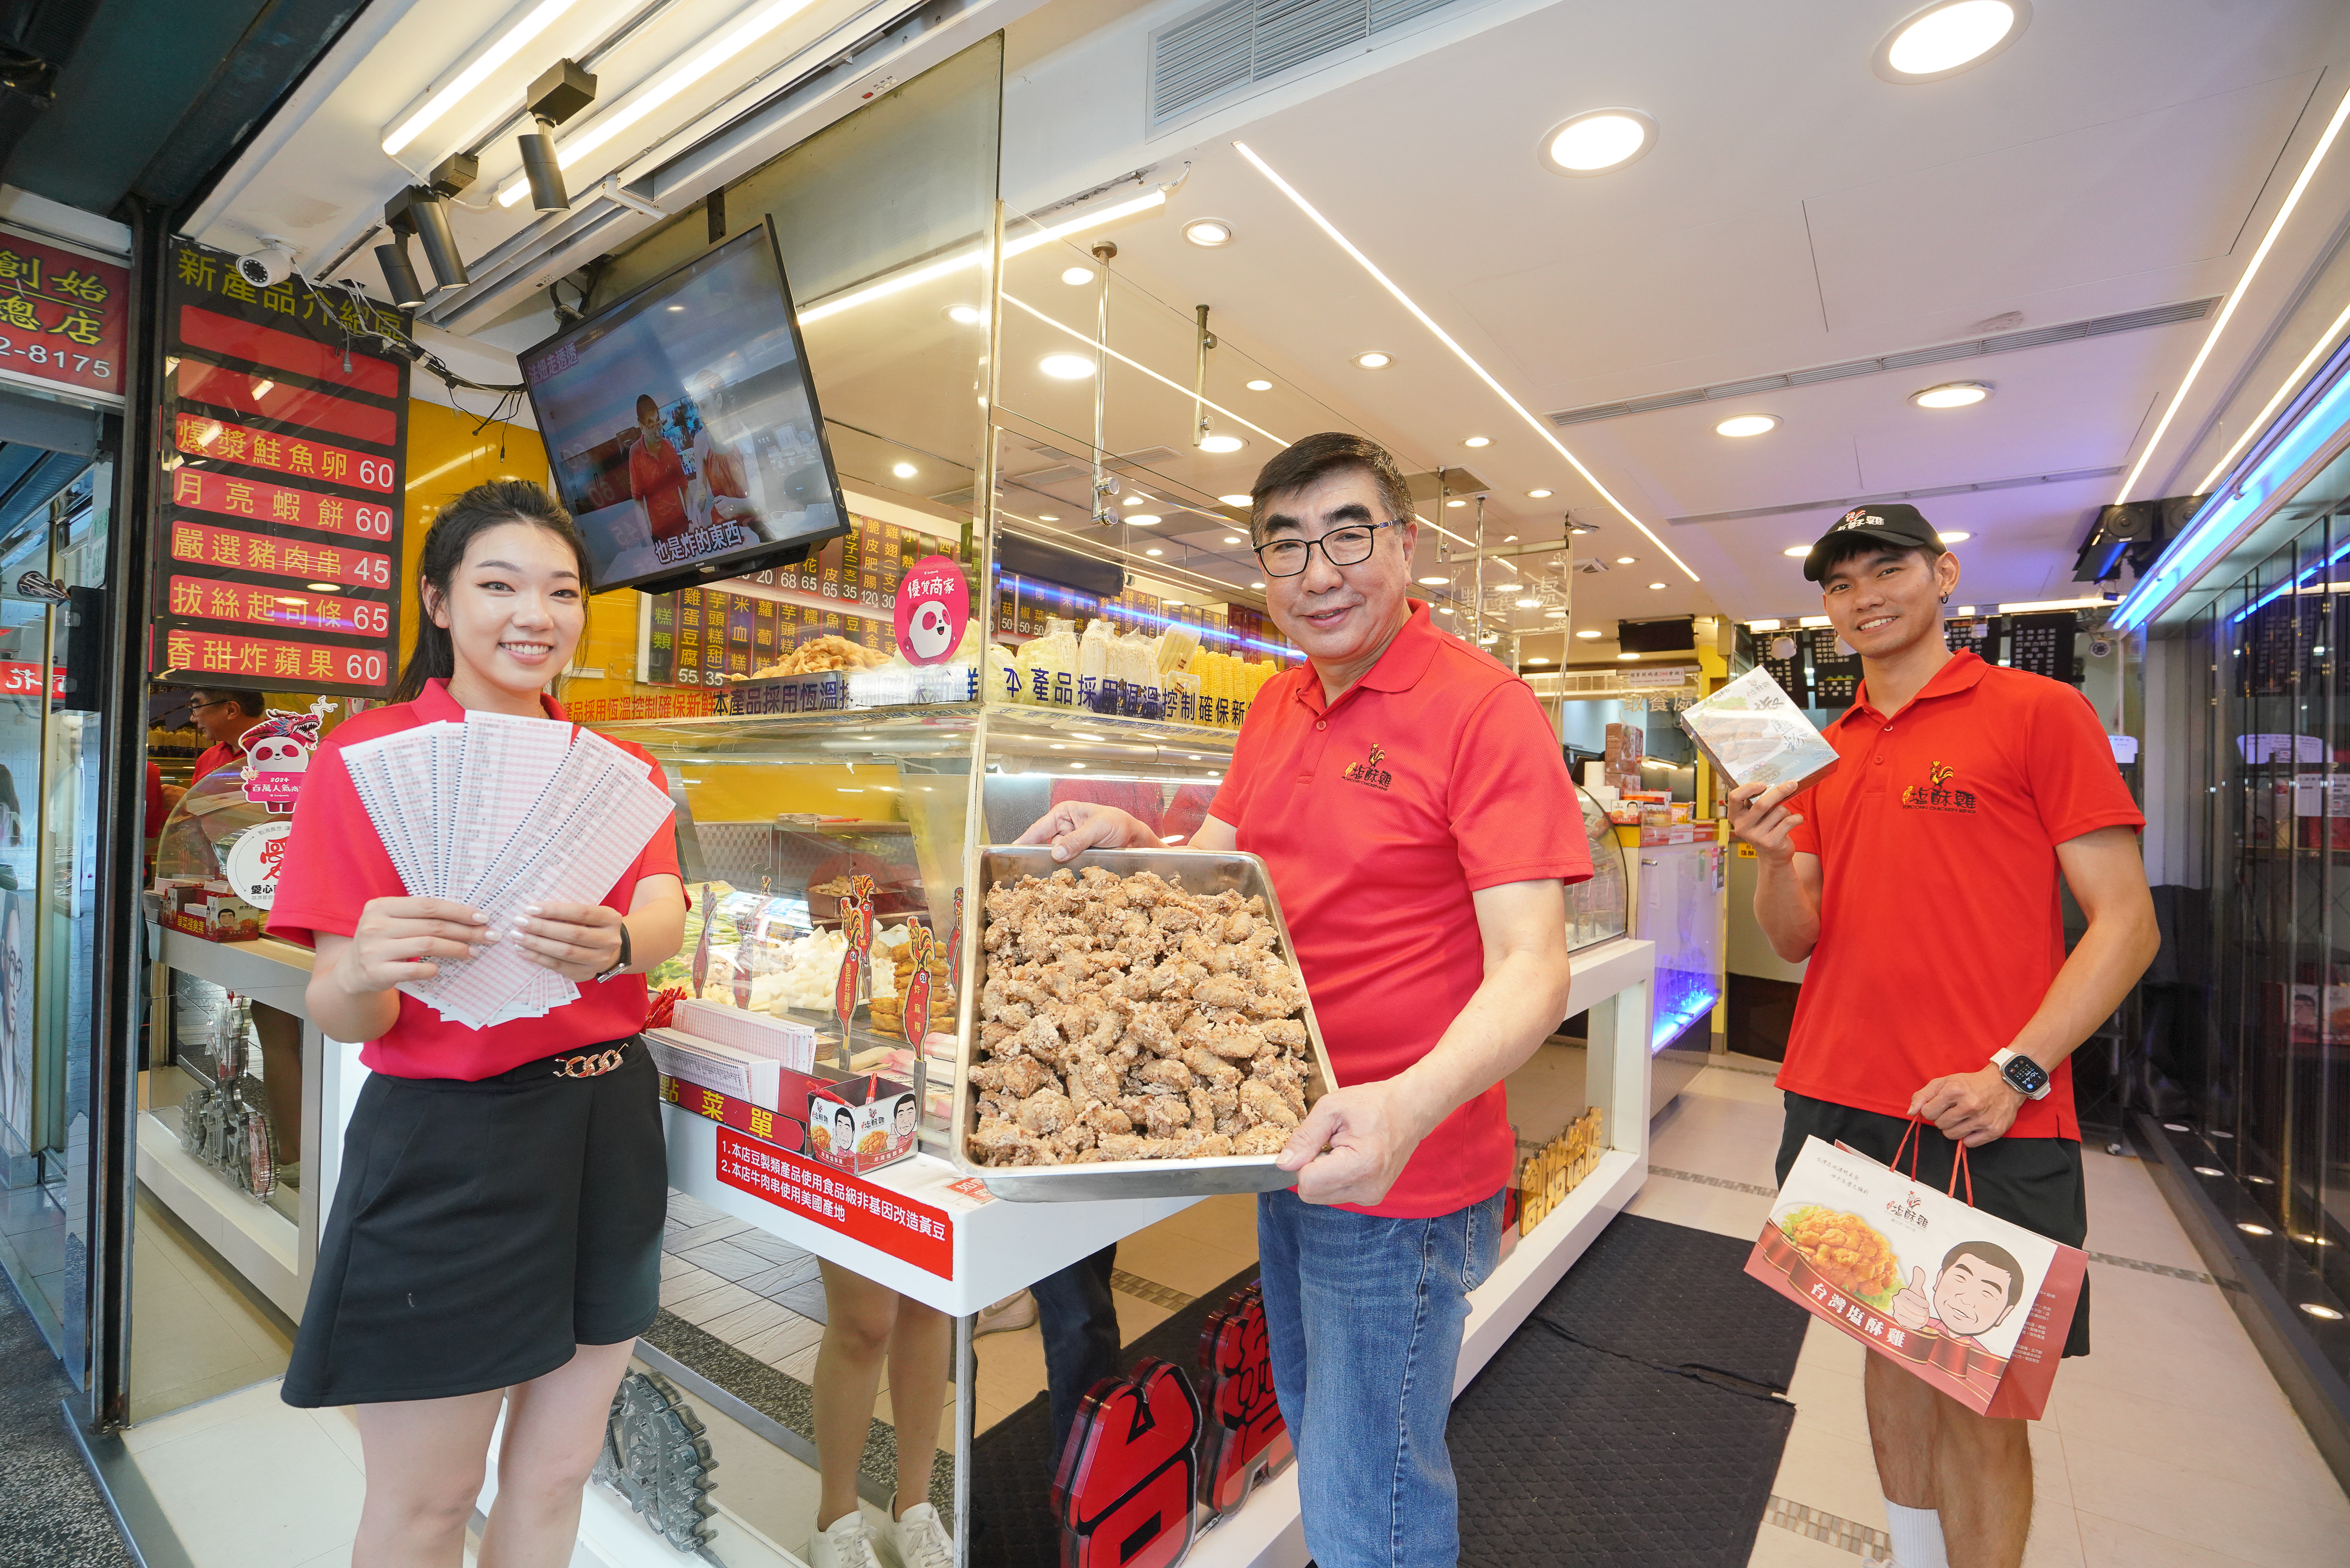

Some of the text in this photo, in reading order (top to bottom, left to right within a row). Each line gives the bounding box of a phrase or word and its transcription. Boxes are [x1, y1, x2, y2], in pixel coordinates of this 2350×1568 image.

[0, 251, 108, 303] 創始
[178, 248, 405, 343] 新產品介紹區
[0, 295, 102, 345] 總店
[0, 336, 110, 378] 2-8175
[179, 420, 393, 488] 爆漿鮭魚卵 60
[179, 473, 390, 535] 月亮蝦餅 60
[173, 527, 389, 584] 嚴選豬肉串 45
[655, 519, 742, 563] 也是炸的東西
[862, 519, 880, 605] 脆皮肥腸 120
[757, 570, 773, 584] 20
[781, 572, 797, 588] 68
[801, 576, 817, 591] 65
[823, 567, 838, 597] 皮 65
[882, 525, 899, 609] 雞翅(一支) 30
[907, 576, 955, 599] 優質商家
[173, 584, 388, 632] 拔絲起司條 65
[843, 585, 857, 599] 35
[679, 588, 701, 682] 雞蛋豆腐 55
[705, 592, 725, 686] 芋頭糕(甜) 35
[731, 597, 750, 671] 米血糕
[756, 600, 773, 670] 蘿蔔糕
[780, 604, 796, 653] 芋頭糕
[1002, 618, 1012, 629] 50
[1019, 622, 1030, 633] 50
[1034, 625, 1044, 635] 50
[167, 635, 381, 680] 香甜炸蘋果 60
[1003, 667, 1251, 726] 本產品採用恆溫控制確保新
[252, 784, 301, 792] 百萬人氣商
[1779, 760, 1801, 774] POWDER
[251, 885, 278, 894] 愛心
[659, 1074, 774, 1139] 點菜單
[721, 1162, 846, 1222] 2.本店牛肉串使用美國產地
[1817, 1157, 1860, 1181] 台灣在地傳統美食
[1810, 1281, 1907, 1348] 台灣塩酥雞
